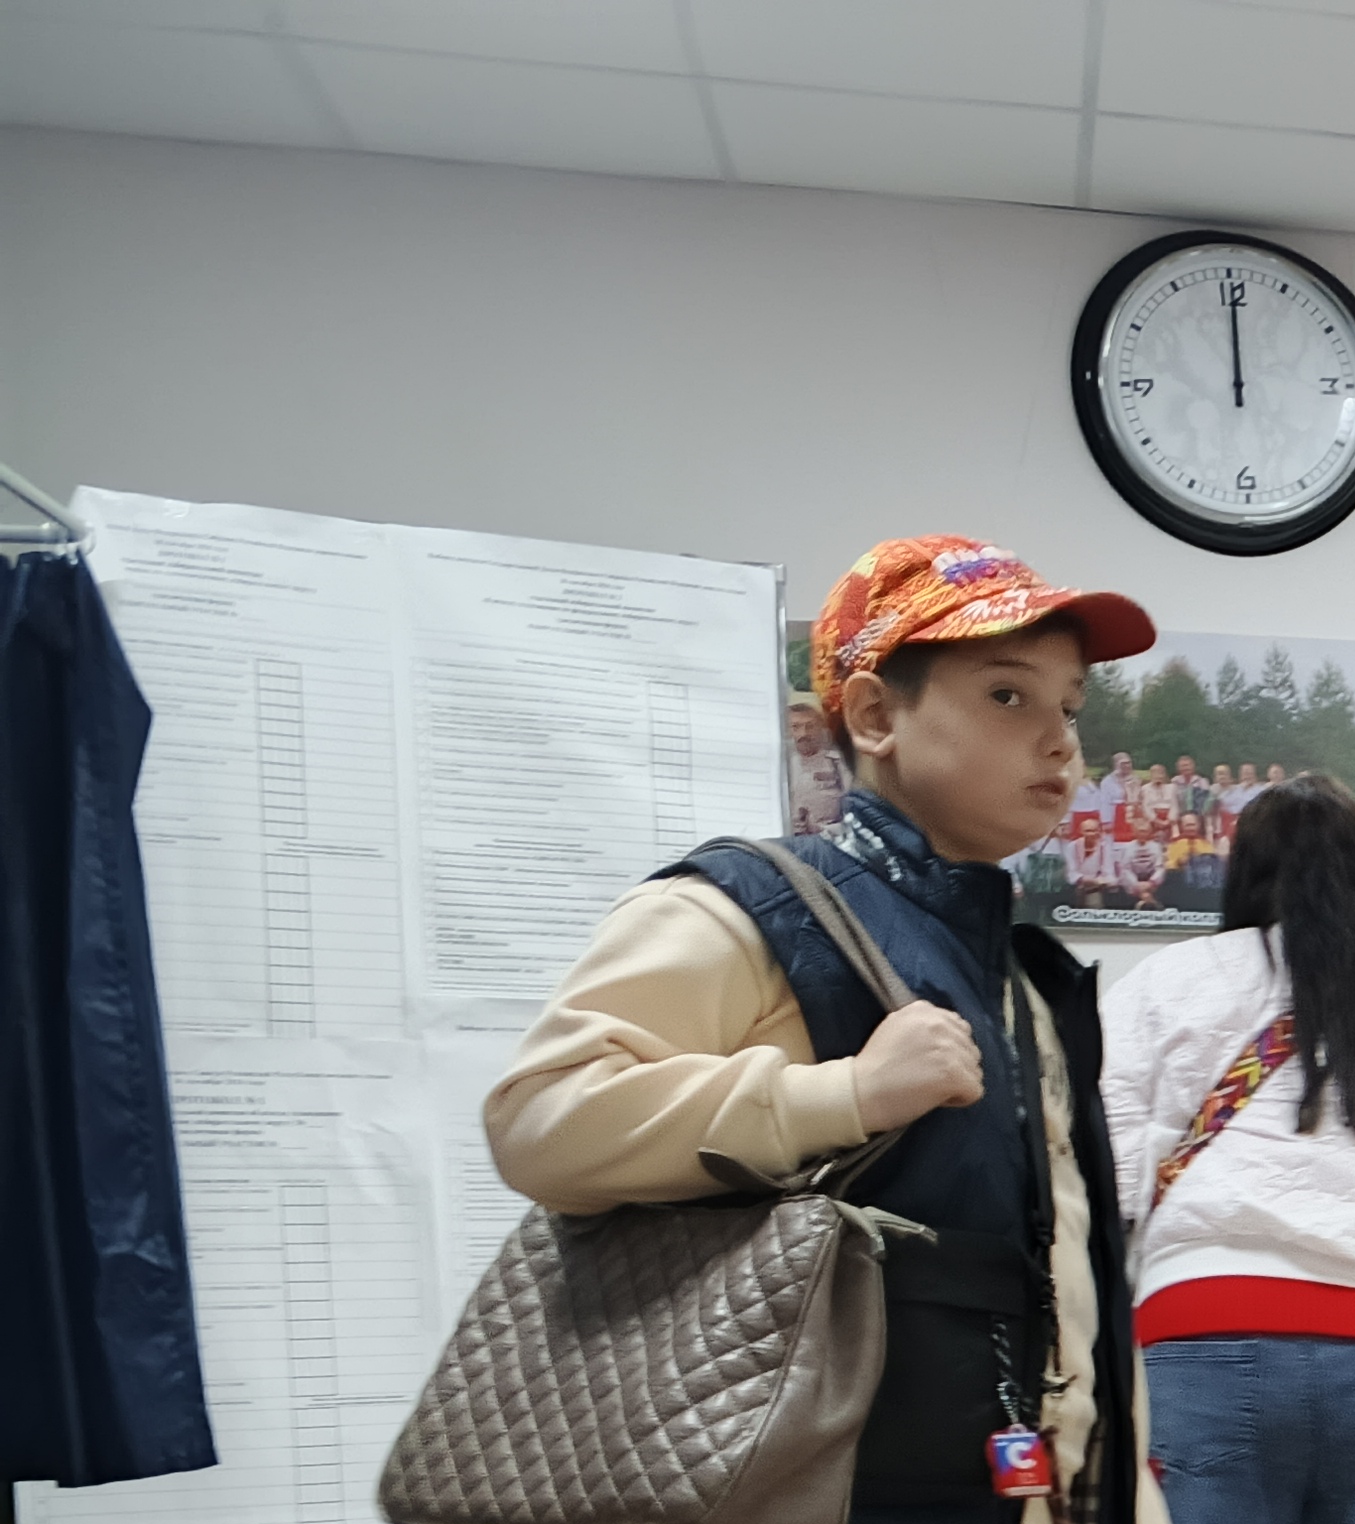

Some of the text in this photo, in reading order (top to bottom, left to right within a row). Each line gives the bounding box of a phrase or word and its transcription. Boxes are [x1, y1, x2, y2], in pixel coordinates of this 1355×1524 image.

[1219, 280, 1248, 307] 12
[1132, 377, 1154, 398] 9
[1236, 465, 1256, 490] 6
